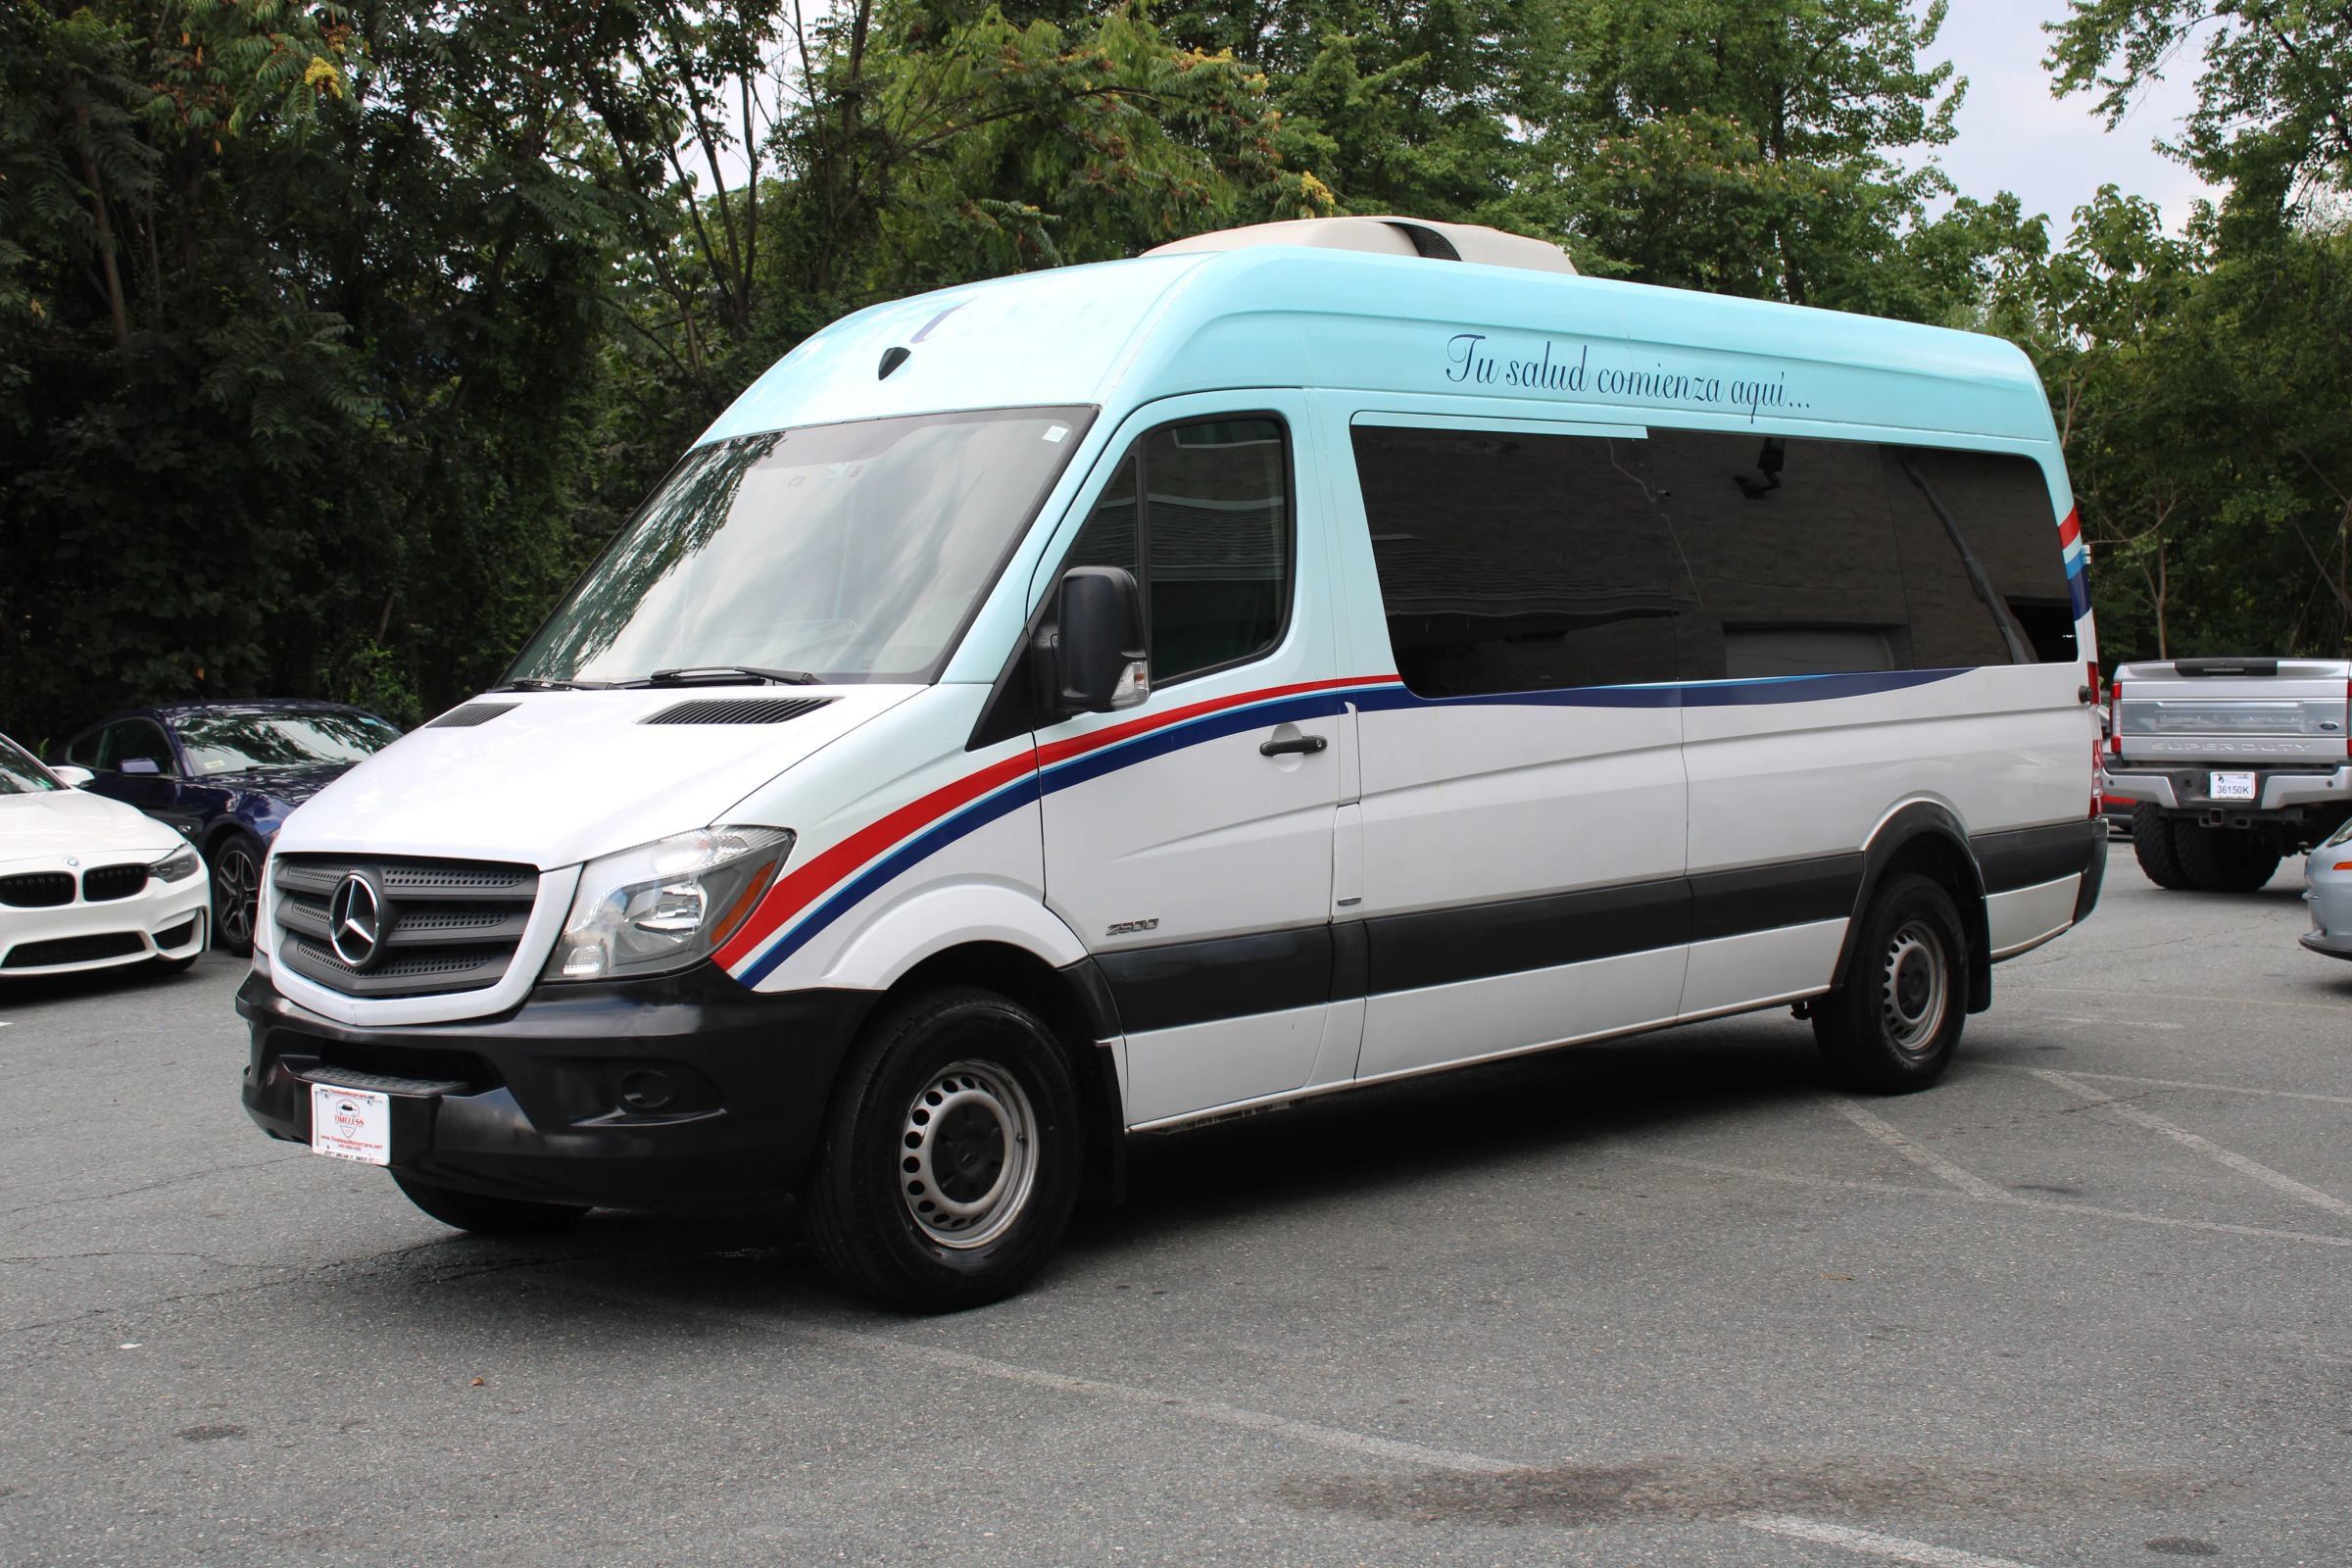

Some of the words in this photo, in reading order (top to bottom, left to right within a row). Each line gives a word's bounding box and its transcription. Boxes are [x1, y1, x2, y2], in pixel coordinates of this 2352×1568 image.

[1446, 333, 1500, 383] Tu
[1506, 340, 1590, 393] salud
[1597, 363, 1725, 404] comienza
[2151, 742, 2234, 752] SUPER
[2241, 743, 2311, 753] DUTY
[2217, 785, 2249, 795] 36150K
